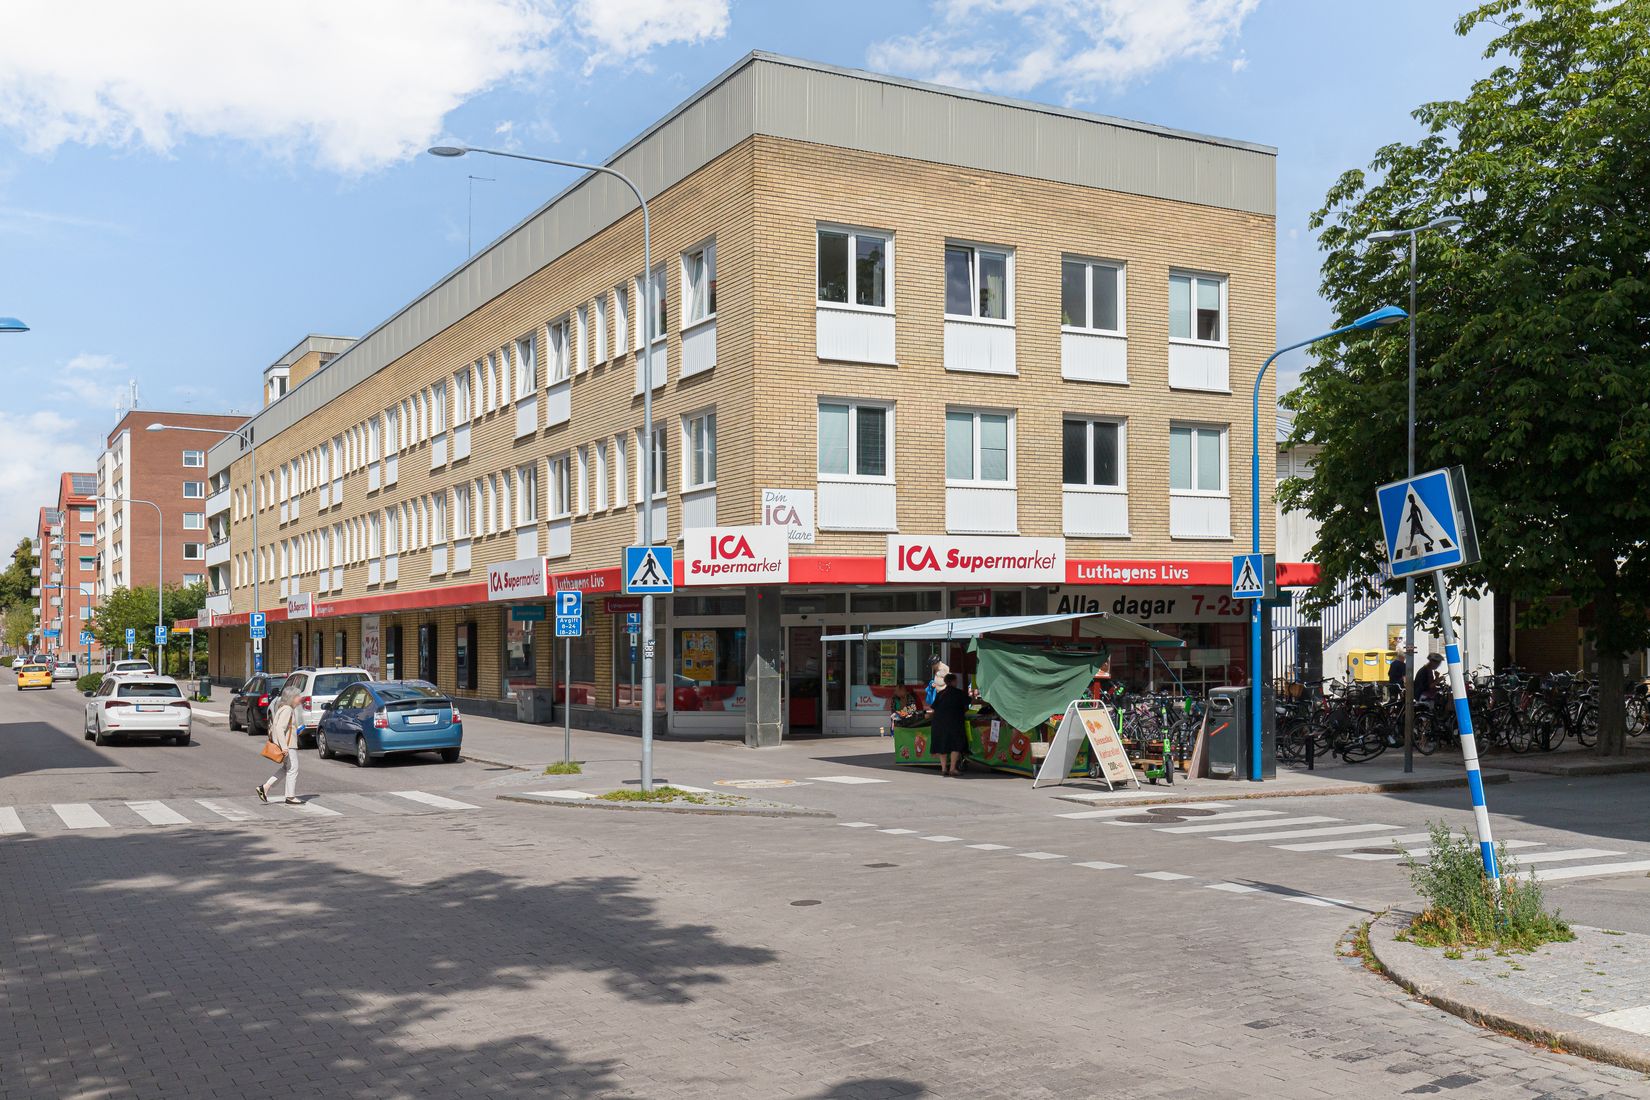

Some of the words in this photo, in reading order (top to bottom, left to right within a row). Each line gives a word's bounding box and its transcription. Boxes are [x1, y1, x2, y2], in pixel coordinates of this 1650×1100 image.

[764, 491, 788, 502] Din
[765, 504, 802, 526] ICA
[711, 534, 755, 560] ICA
[691, 557, 782, 576] Supermarket
[898, 545, 941, 571] ICA
[946, 548, 1056, 573] Supermarket
[490, 571, 503, 592] ICA
[503, 567, 541, 591] Supermarket
[590, 573, 605, 588] Livs
[1077, 564, 1156, 583] Luthagens
[1161, 565, 1189, 579] Livs
[563, 593, 577, 614] P
[1056, 594, 1099, 614] Alla
[1112, 595, 1175, 619] dagar
[1191, 594, 1245, 616] 7-23
[253, 614, 263, 626] P
[128, 629, 134, 637] P
[158, 627, 165, 636] P
